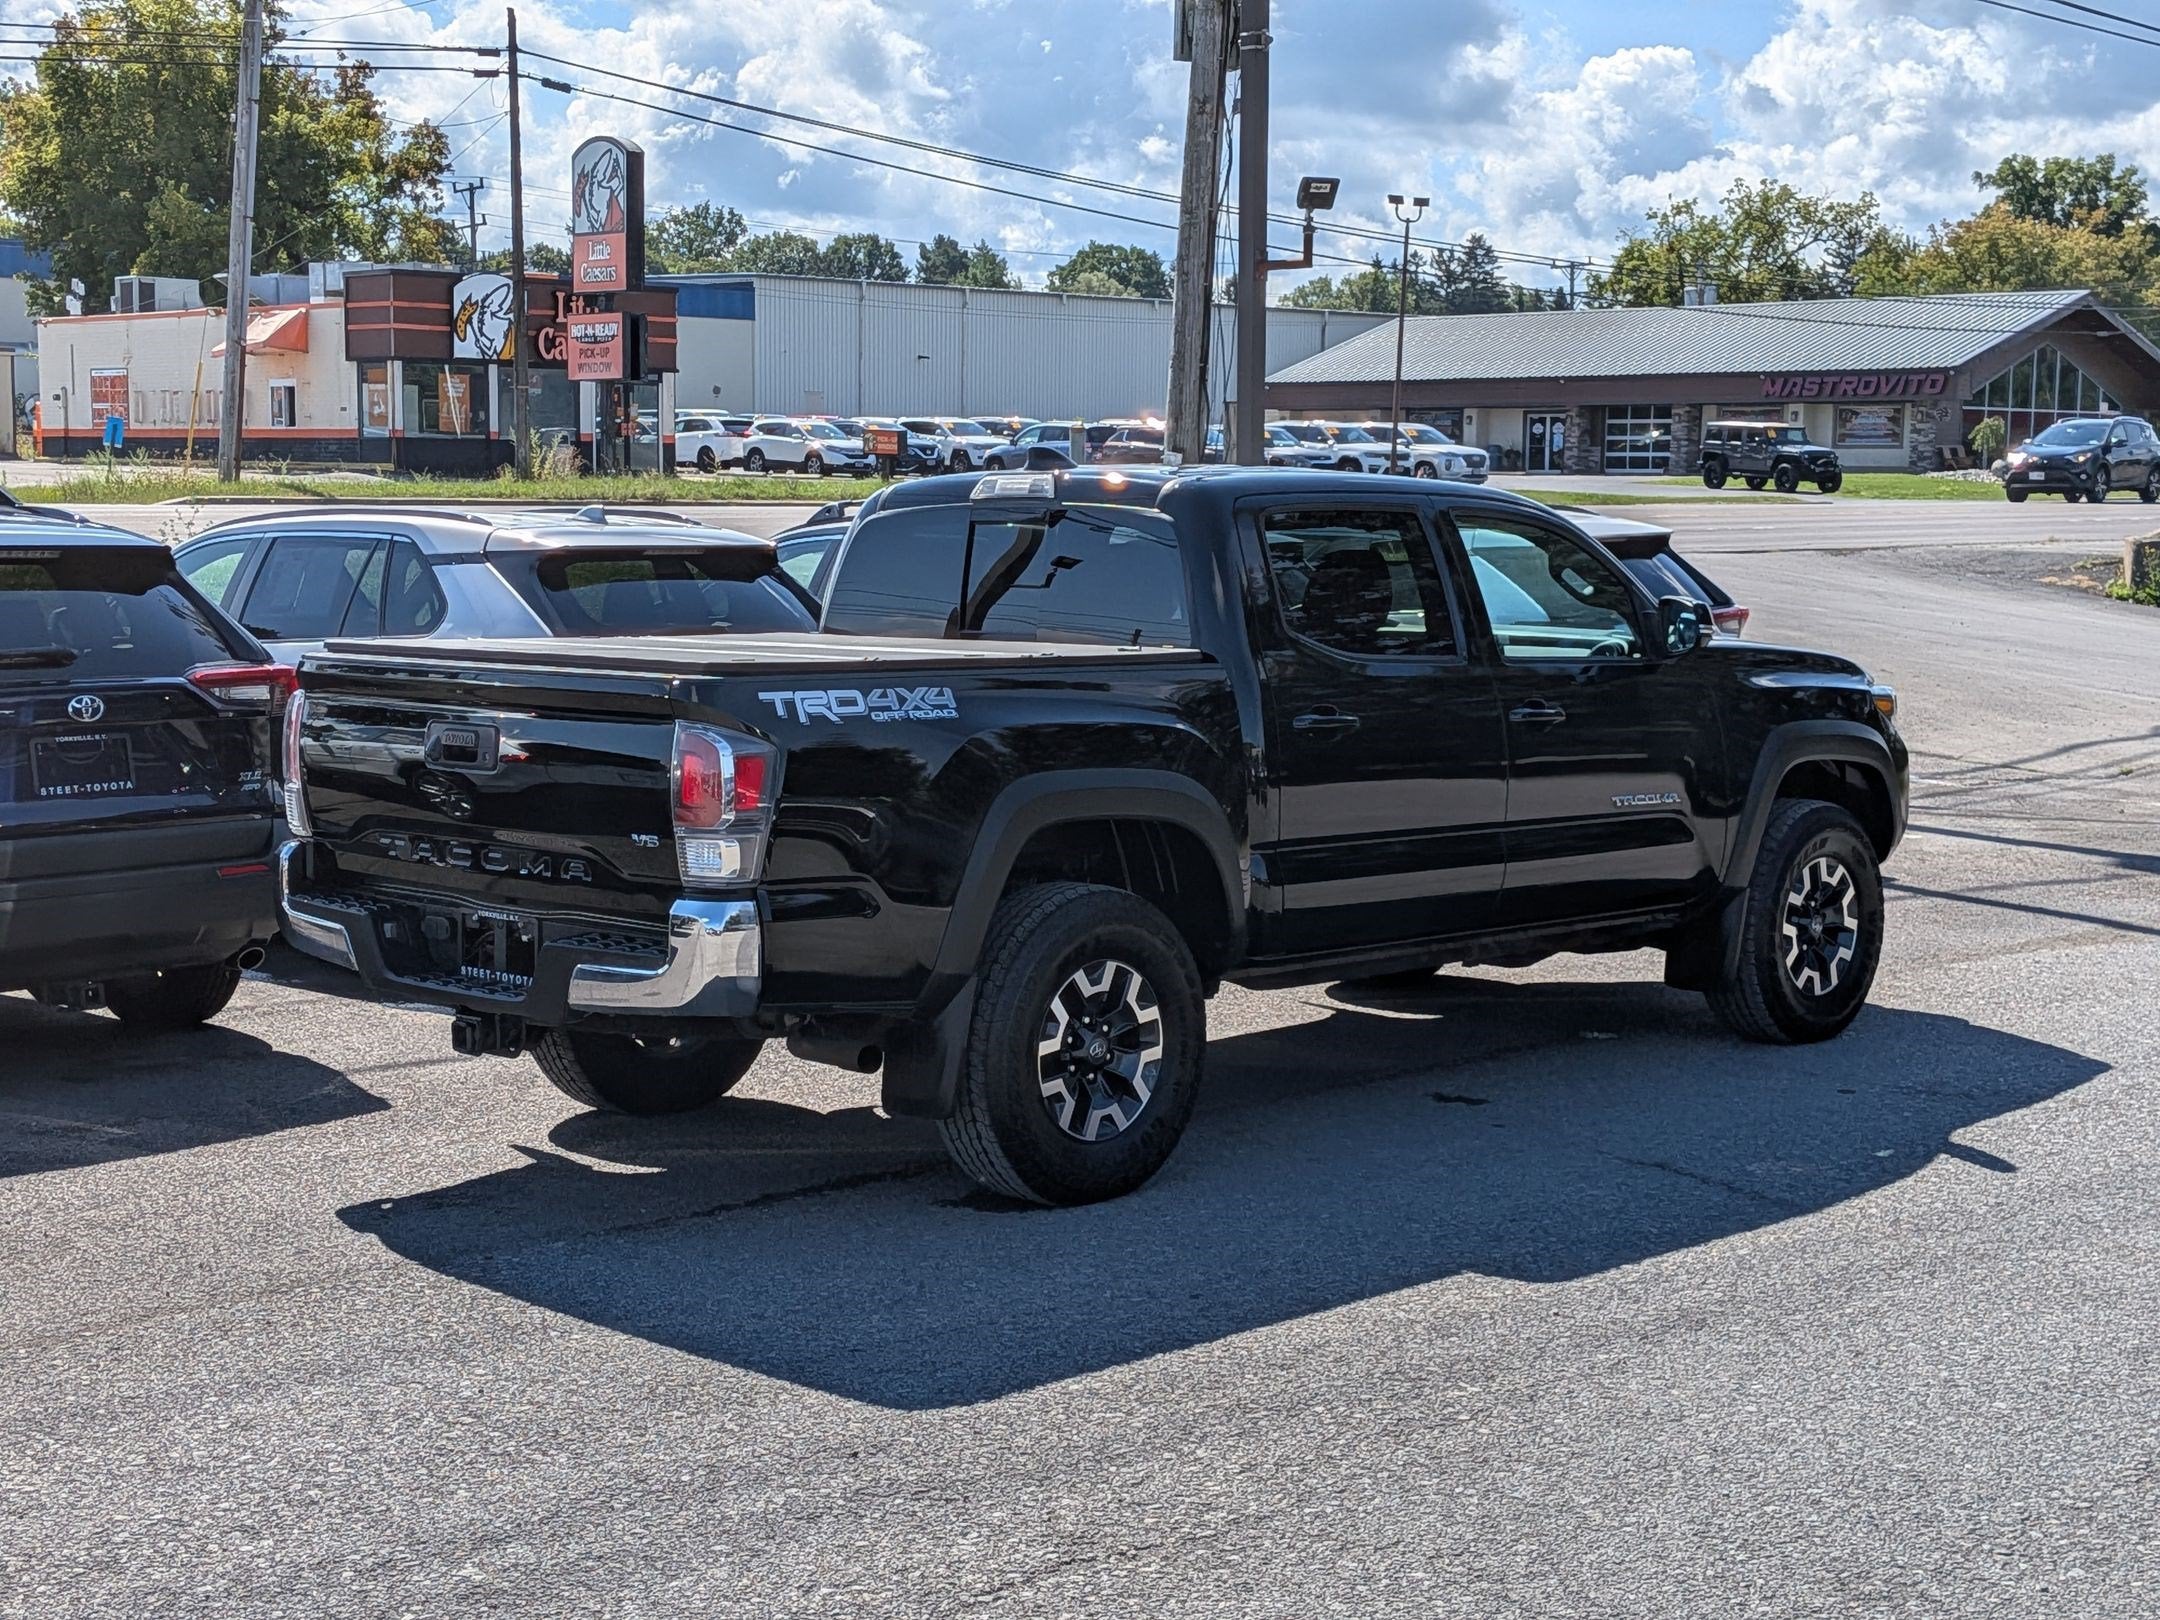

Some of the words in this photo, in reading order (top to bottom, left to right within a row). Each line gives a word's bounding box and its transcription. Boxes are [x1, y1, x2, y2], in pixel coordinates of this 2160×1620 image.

[588, 240, 611, 261] Little
[580, 262, 616, 283] Caesars
[571, 322, 619, 338] HOT-N-READY
[578, 346, 610, 359] PICK-UP
[577, 361, 612, 374] WINDOW
[1762, 373, 1946, 398] MASTROVITO
[870, 710, 907, 722] OFF
[907, 709, 960, 721] ROAD
[40, 780, 134, 796] STEET-TOYOTA
[631, 833, 660, 848] V6
